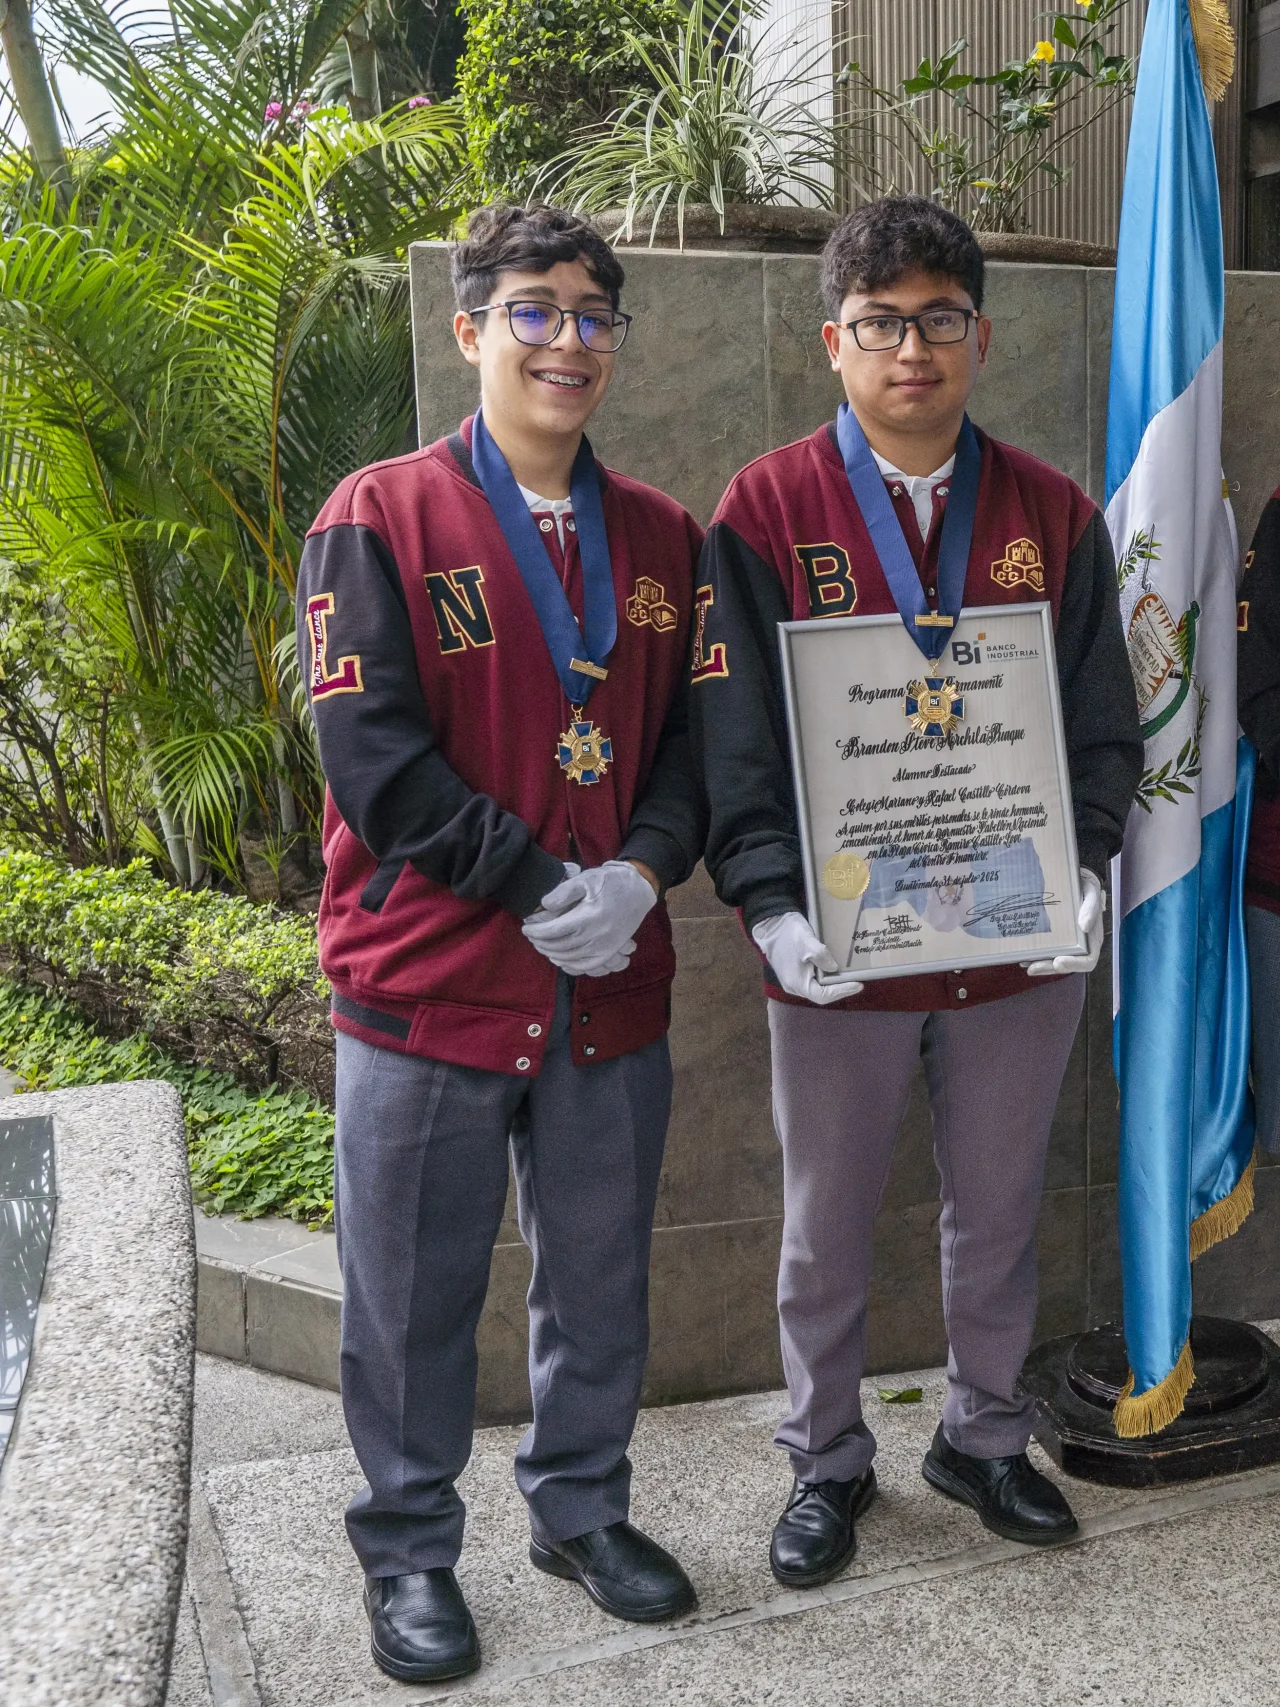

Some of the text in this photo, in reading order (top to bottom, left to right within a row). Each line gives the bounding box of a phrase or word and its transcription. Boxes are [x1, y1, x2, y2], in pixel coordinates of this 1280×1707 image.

[793, 541, 857, 618] B
[313, 609, 323, 640] dance
[424, 565, 496, 655] N
[305, 592, 364, 703] L
[952, 636, 983, 665] Bi
[986, 643, 1016, 652] BANCO
[987, 649, 1039, 659] INDUSTRIAL
[314, 664, 323, 687] The
[848, 683, 905, 705] Programa
[946, 673, 1004, 692] Prmanente
[835, 735, 900, 760] Brandon
[900, 732, 936, 754] Steve
[892, 763, 976, 782] Alumno Destacado
[840, 798, 880, 816] Colegio
[875, 795, 919, 813] Mariano
[923, 788, 956, 808] Rafael
[959, 785, 995, 803] Castillo
[996, 783, 1031, 799] Córdova
[980, 870, 1000, 883] 2025
